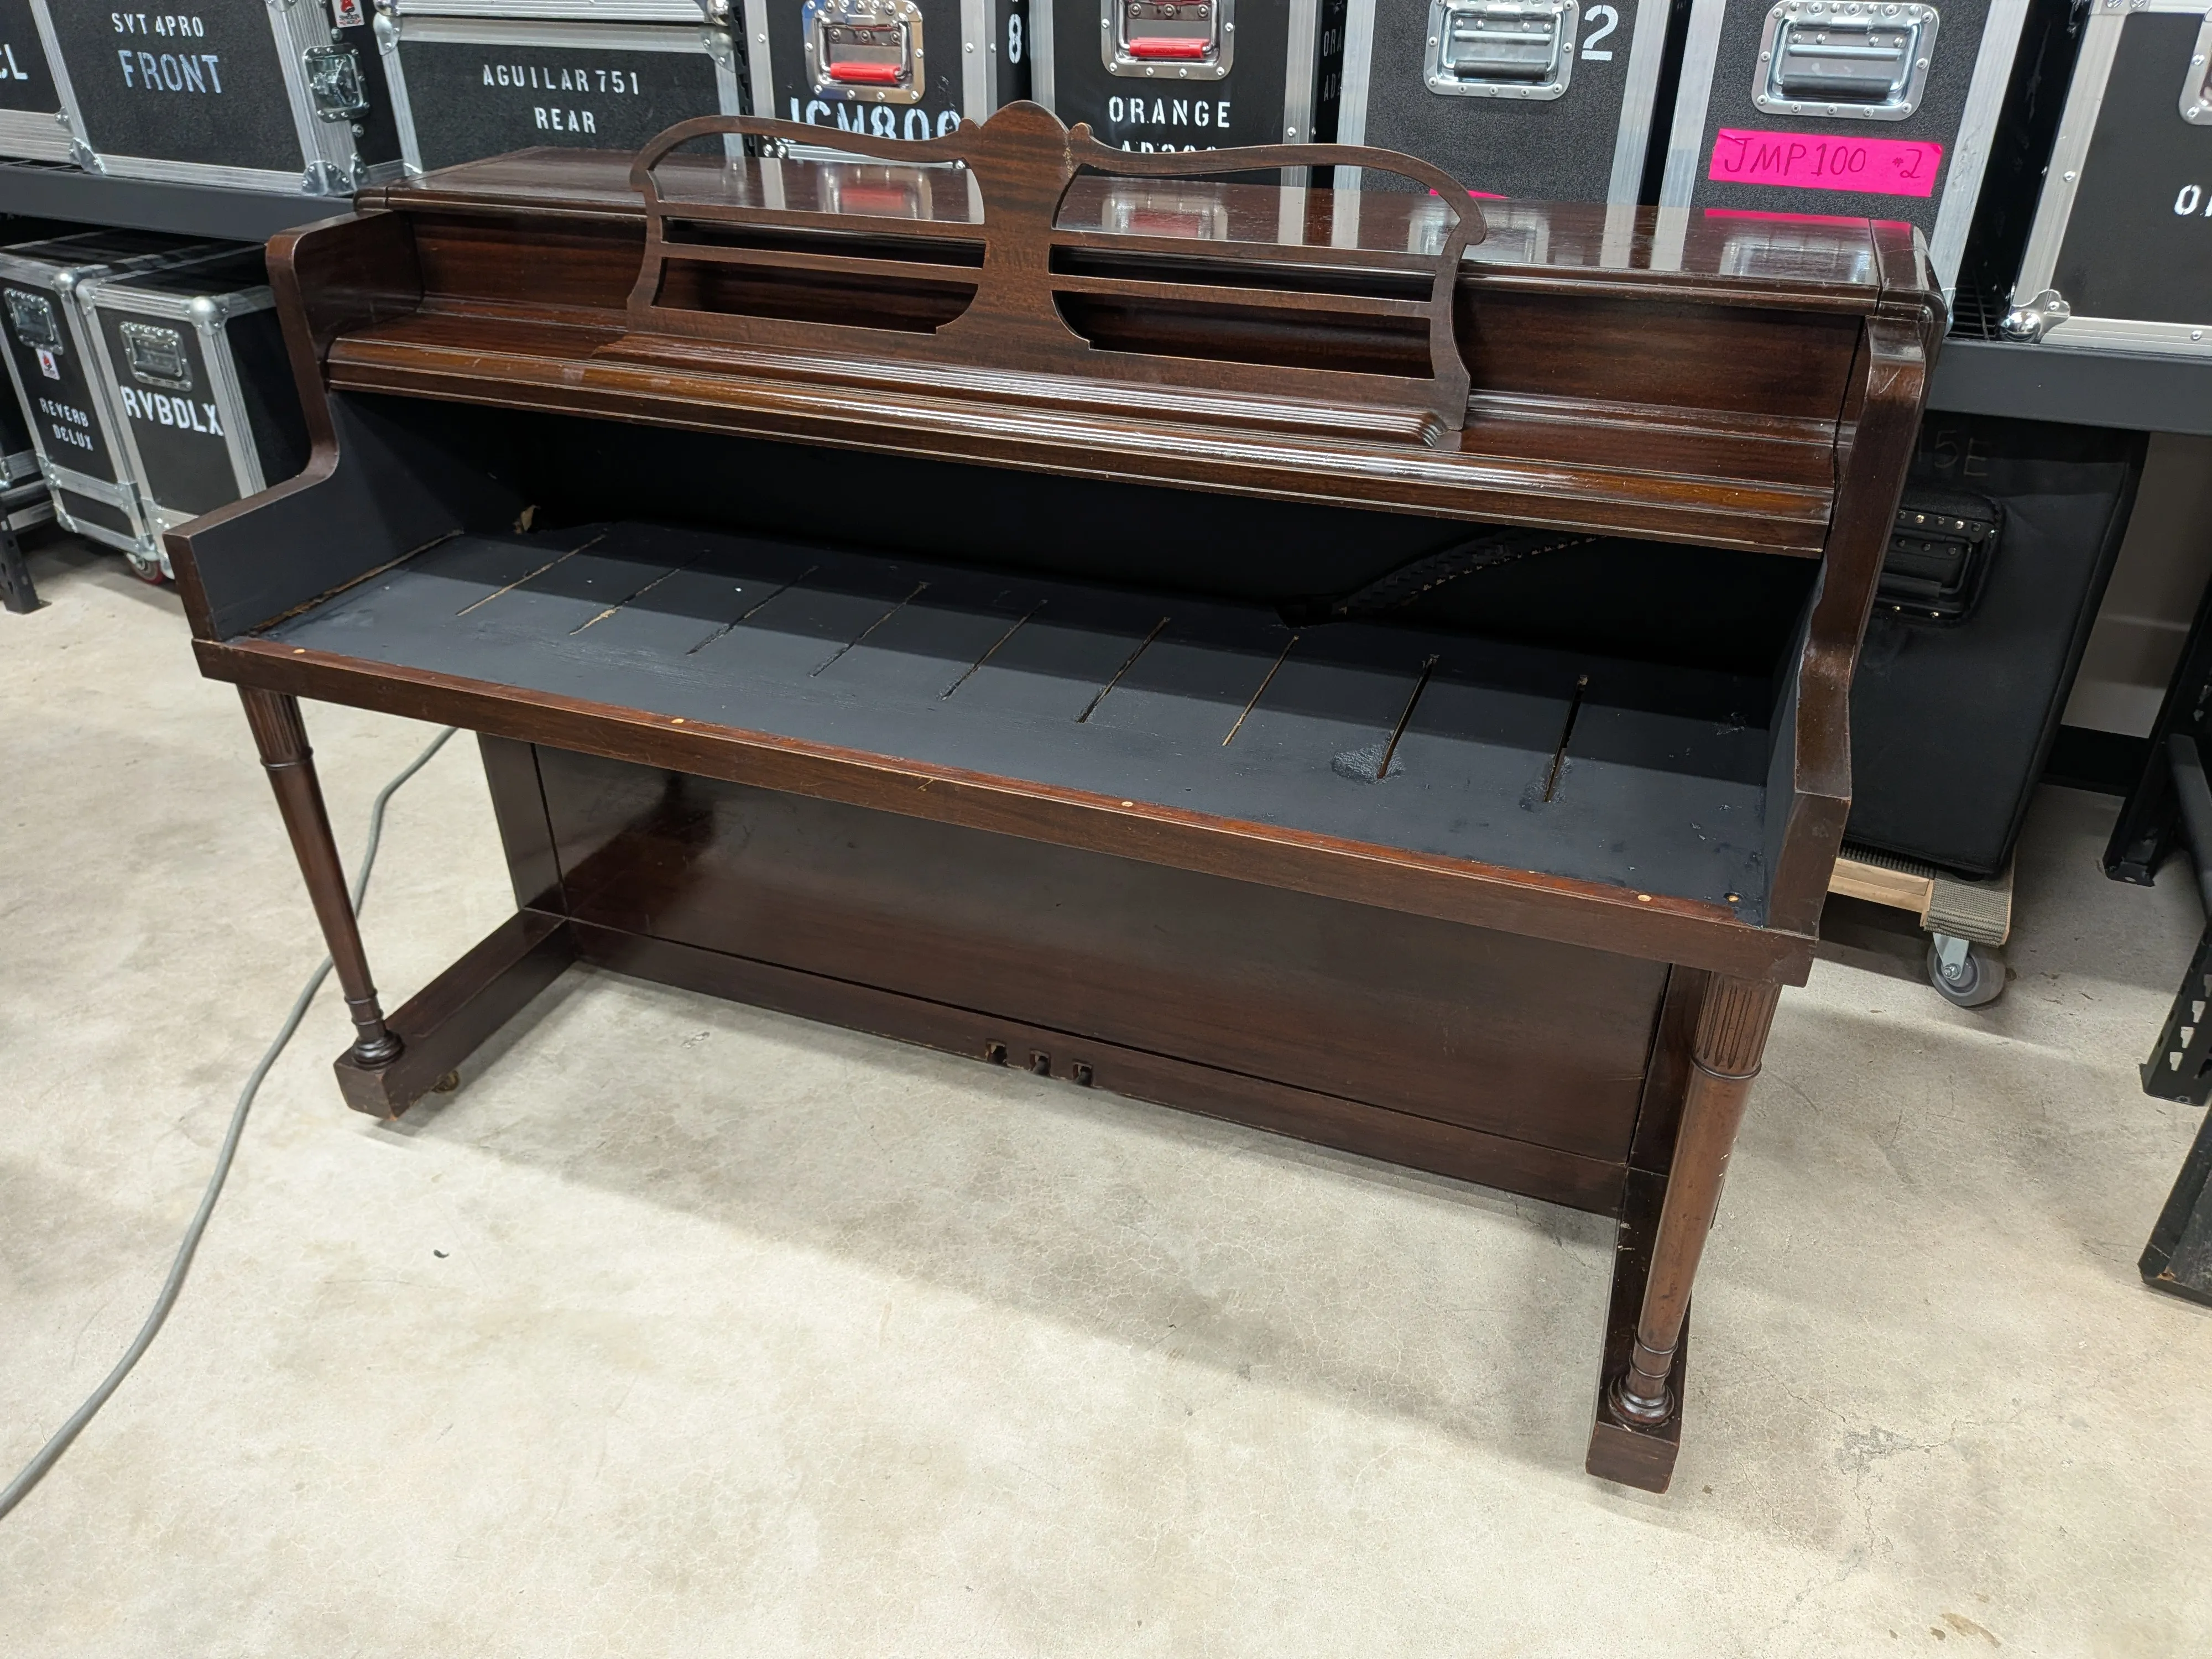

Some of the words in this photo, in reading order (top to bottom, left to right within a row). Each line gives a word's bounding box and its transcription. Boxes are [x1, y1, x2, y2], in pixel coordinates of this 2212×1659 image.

[112, 13, 148, 34] SVT
[155, 15, 204, 37] 4PRO
[1582, 5, 1618, 61] 2
[118, 50, 221, 93] FRONT
[483, 64, 589, 92] AGUILAR
[594, 70, 639, 95] 751
[534, 107, 597, 134] REAR
[1108, 96, 1231, 128] ORANGE
[1724, 138, 1867, 176] JMP100
[1892, 148, 1923, 179] #2
[2173, 184, 2212, 217] O
[39, 397, 89, 427] REVERB
[119, 385, 224, 436] RVBDLX
[52, 423, 94, 451] DELUX
